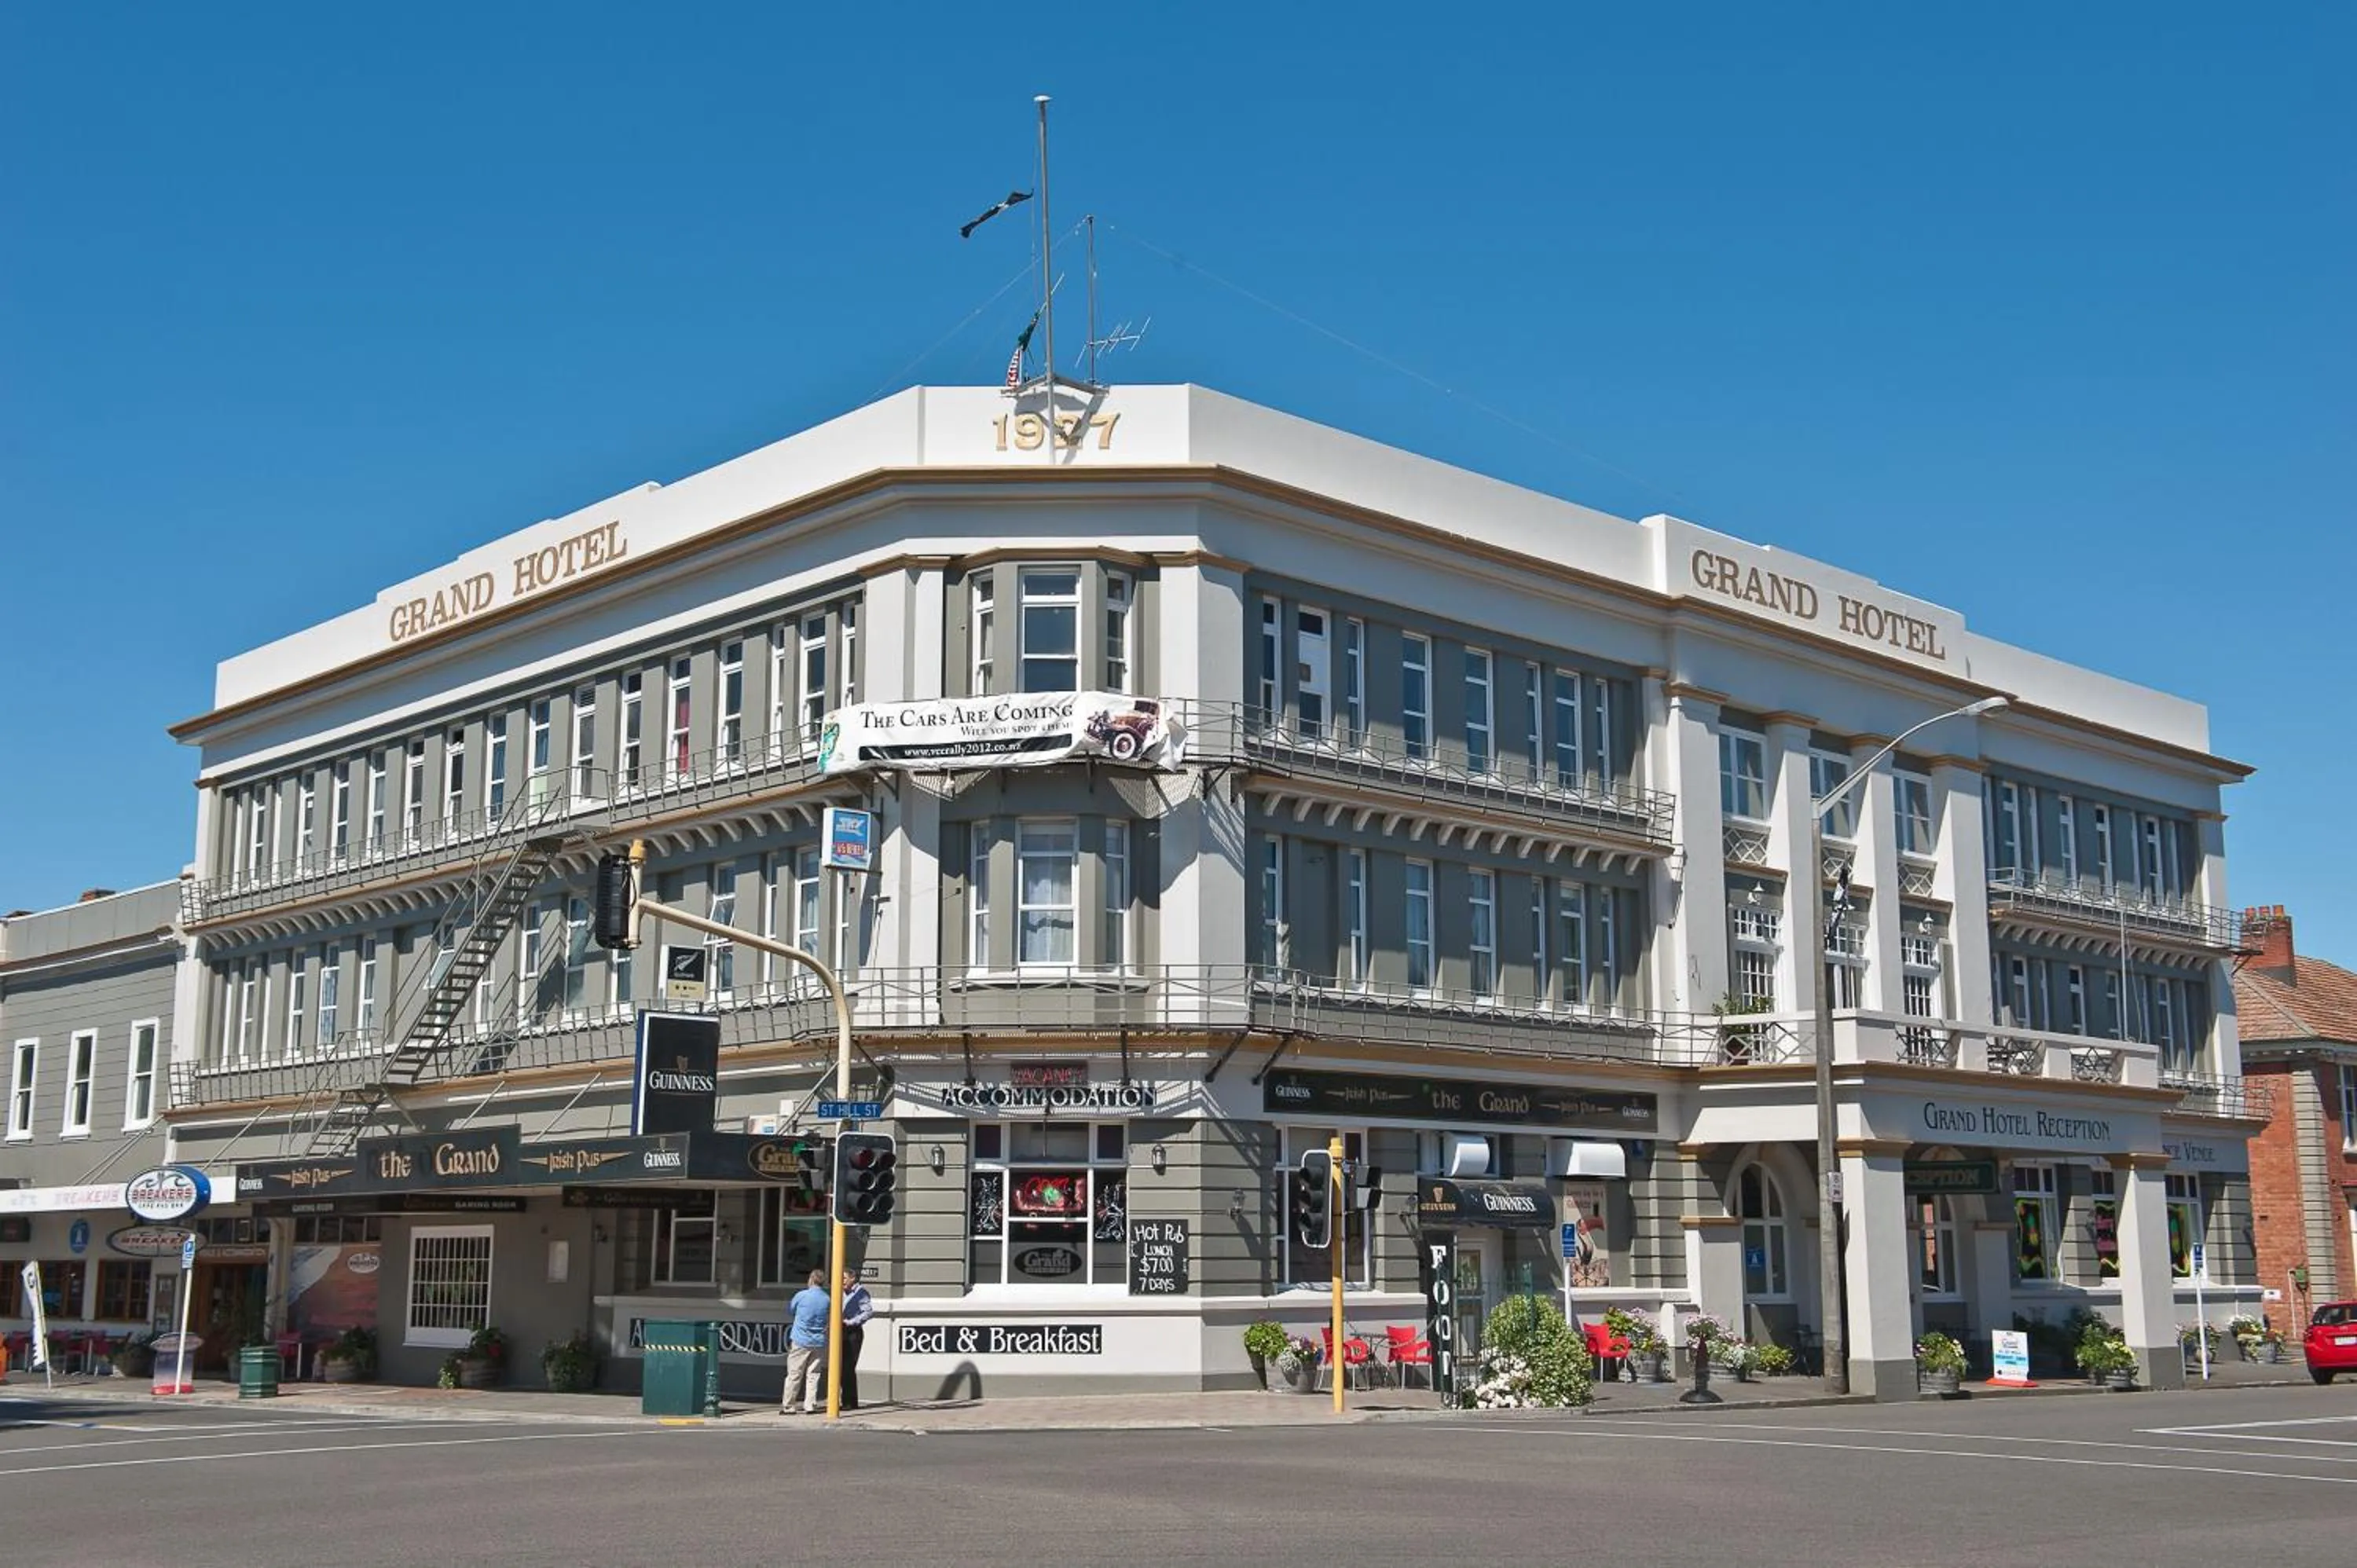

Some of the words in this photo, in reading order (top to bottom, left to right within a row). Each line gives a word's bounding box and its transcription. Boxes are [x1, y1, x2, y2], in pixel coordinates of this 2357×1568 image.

[992, 413, 1121, 452] 1927
[389, 572, 495, 643] GRAND
[512, 520, 629, 597] HOTEL
[1691, 549, 1820, 621] GRAND
[1838, 595, 1946, 661] HOTEL
[860, 710, 895, 729] THE
[900, 709, 947, 727] CARS
[951, 705, 989, 725] ARE
[994, 703, 1073, 722] COMING
[649, 1070, 716, 1092] GUINNESS
[1275, 1084, 1312, 1098] GUINNESS
[944, 1086, 1157, 1107] ACCOMMODATION
[1431, 1089, 1462, 1111] the
[1479, 1090, 1530, 1114] Grand
[821, 1104, 834, 1116] ST
[865, 1104, 878, 1116] ST
[1924, 1101, 1978, 1133] GRAND
[1981, 1107, 2032, 1136] HOTEL
[2036, 1110, 2112, 1141] RECEPTION
[378, 1150, 412, 1178] the
[435, 1142, 500, 1176] Grand
[549, 1149, 575, 1174] Irish
[643, 1150, 682, 1168] GUINNESS
[1483, 1193, 1538, 1213] GUINNESS
[120, 1235, 185, 1247] BREAKE
[1138, 1277, 1147, 1292] 7
[901, 1327, 946, 1353] Bed
[956, 1326, 978, 1353] &
[990, 1326, 1101, 1353] Breakfast
